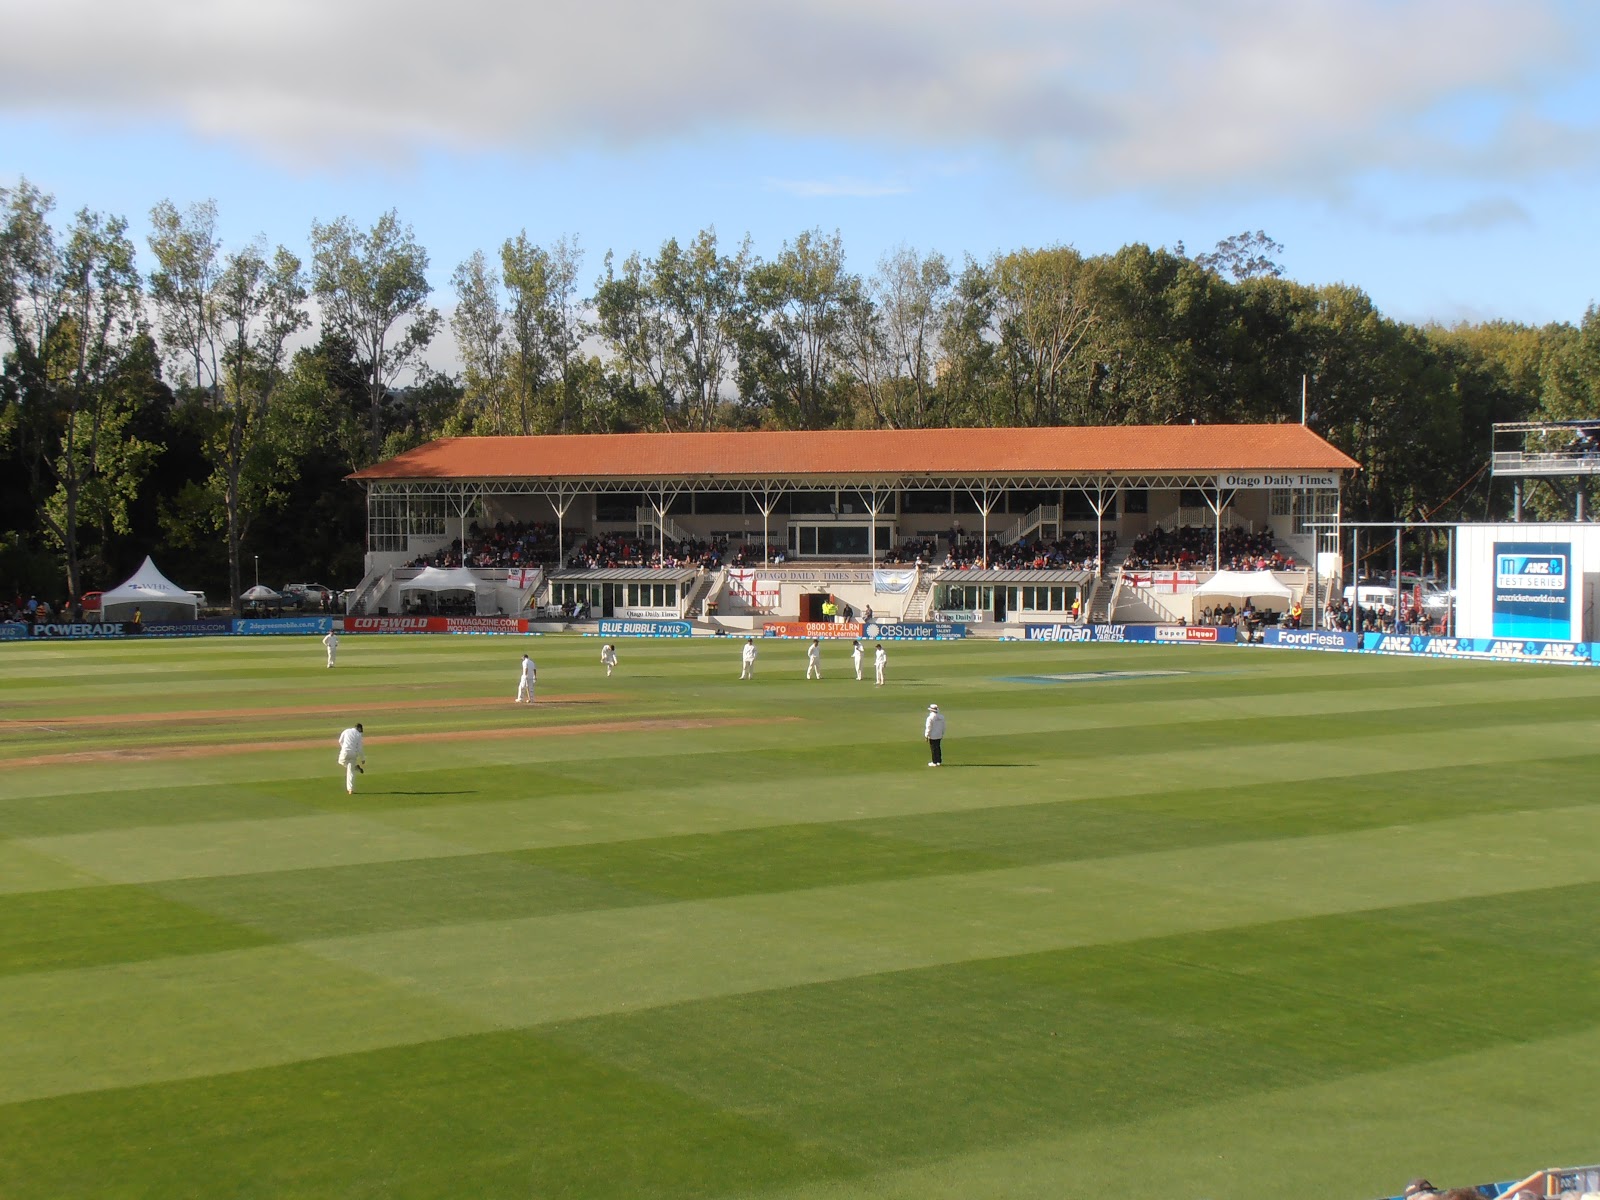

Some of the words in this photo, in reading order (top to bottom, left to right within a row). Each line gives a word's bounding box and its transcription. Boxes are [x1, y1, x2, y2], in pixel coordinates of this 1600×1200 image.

[1226, 475, 1260, 486] Otago
[1264, 475, 1294, 487] Daily
[1298, 475, 1333, 485] Times
[1524, 562, 1549, 574] ANZ
[756, 572, 787, 580] OTAGO
[790, 572, 816, 580] DAILY
[823, 572, 850, 580] TIMES
[1499, 577, 1523, 586] TEST
[1527, 577, 1563, 587] SERIES
[626, 610, 644, 618] Otago
[645, 610, 660, 618] Daily
[955, 614, 972, 622] Daily
[249, 621, 316, 631] 2degreesmobile.co.nz
[354, 618, 428, 628] COTSWOLD
[446, 618, 519, 627] TNTMAGAZINE.COM
[601, 622, 622, 632] BLUE
[623, 622, 657, 633] BUBBLE
[658, 625, 681, 633] TAXIS
[806, 623, 826, 631] 0800
[828, 623, 860, 631] SIT2LRN
[34, 624, 124, 636] POWERADE
[833, 630, 860, 638] Learning
[1030, 625, 1091, 640] wellman
[1094, 624, 1126, 635] VITALITY
[1188, 629, 1214, 639] Liquor
[1096, 633, 1125, 641] TABLETS
[1379, 636, 1411, 651] ANZ
[1425, 638, 1458, 653] ANZ
[1490, 641, 1524, 656] ANZ
[1539, 643, 1575, 658] ANZ
